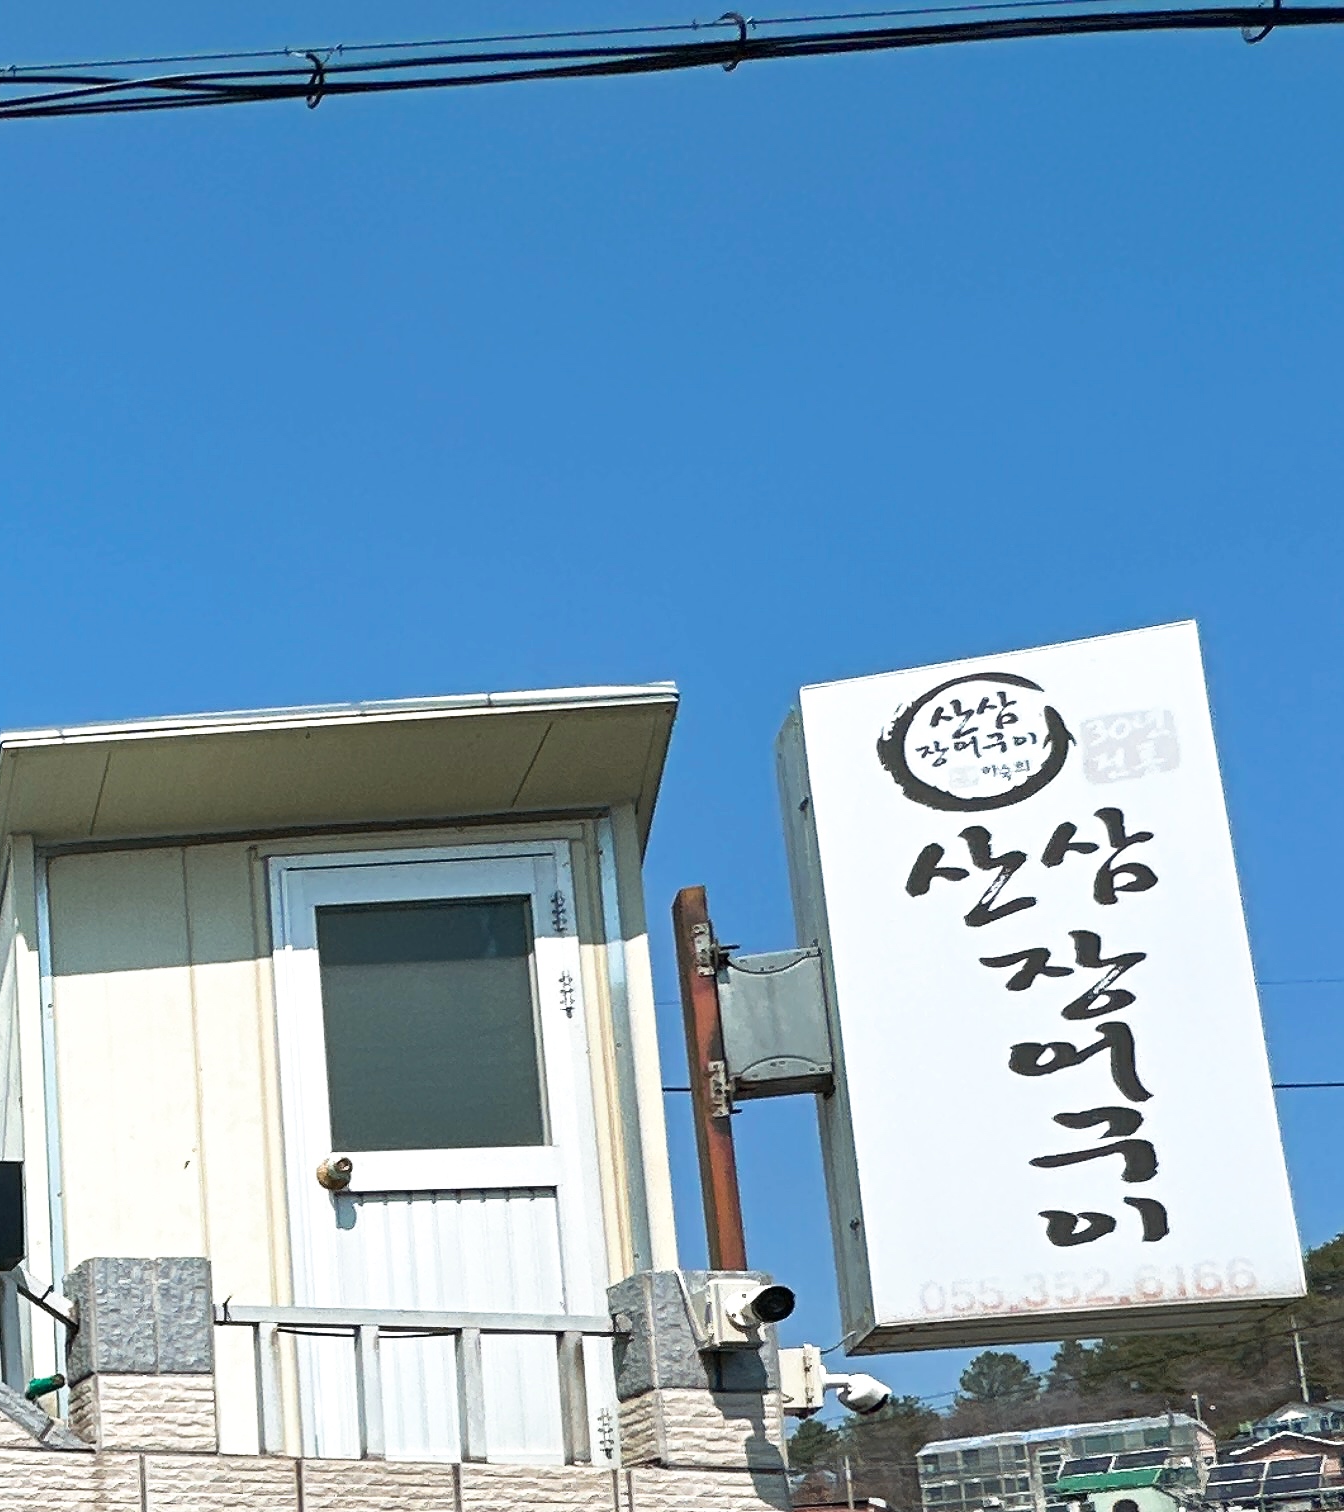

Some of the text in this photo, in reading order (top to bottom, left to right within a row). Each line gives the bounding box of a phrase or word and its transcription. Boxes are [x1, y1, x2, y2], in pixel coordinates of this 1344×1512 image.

[915, 732, 1038, 768] 장어구이
[929, 691, 1019, 740] 산삼
[905, 807, 1159, 928] 산삼
[980, 929, 1170, 1248] 장어구이
